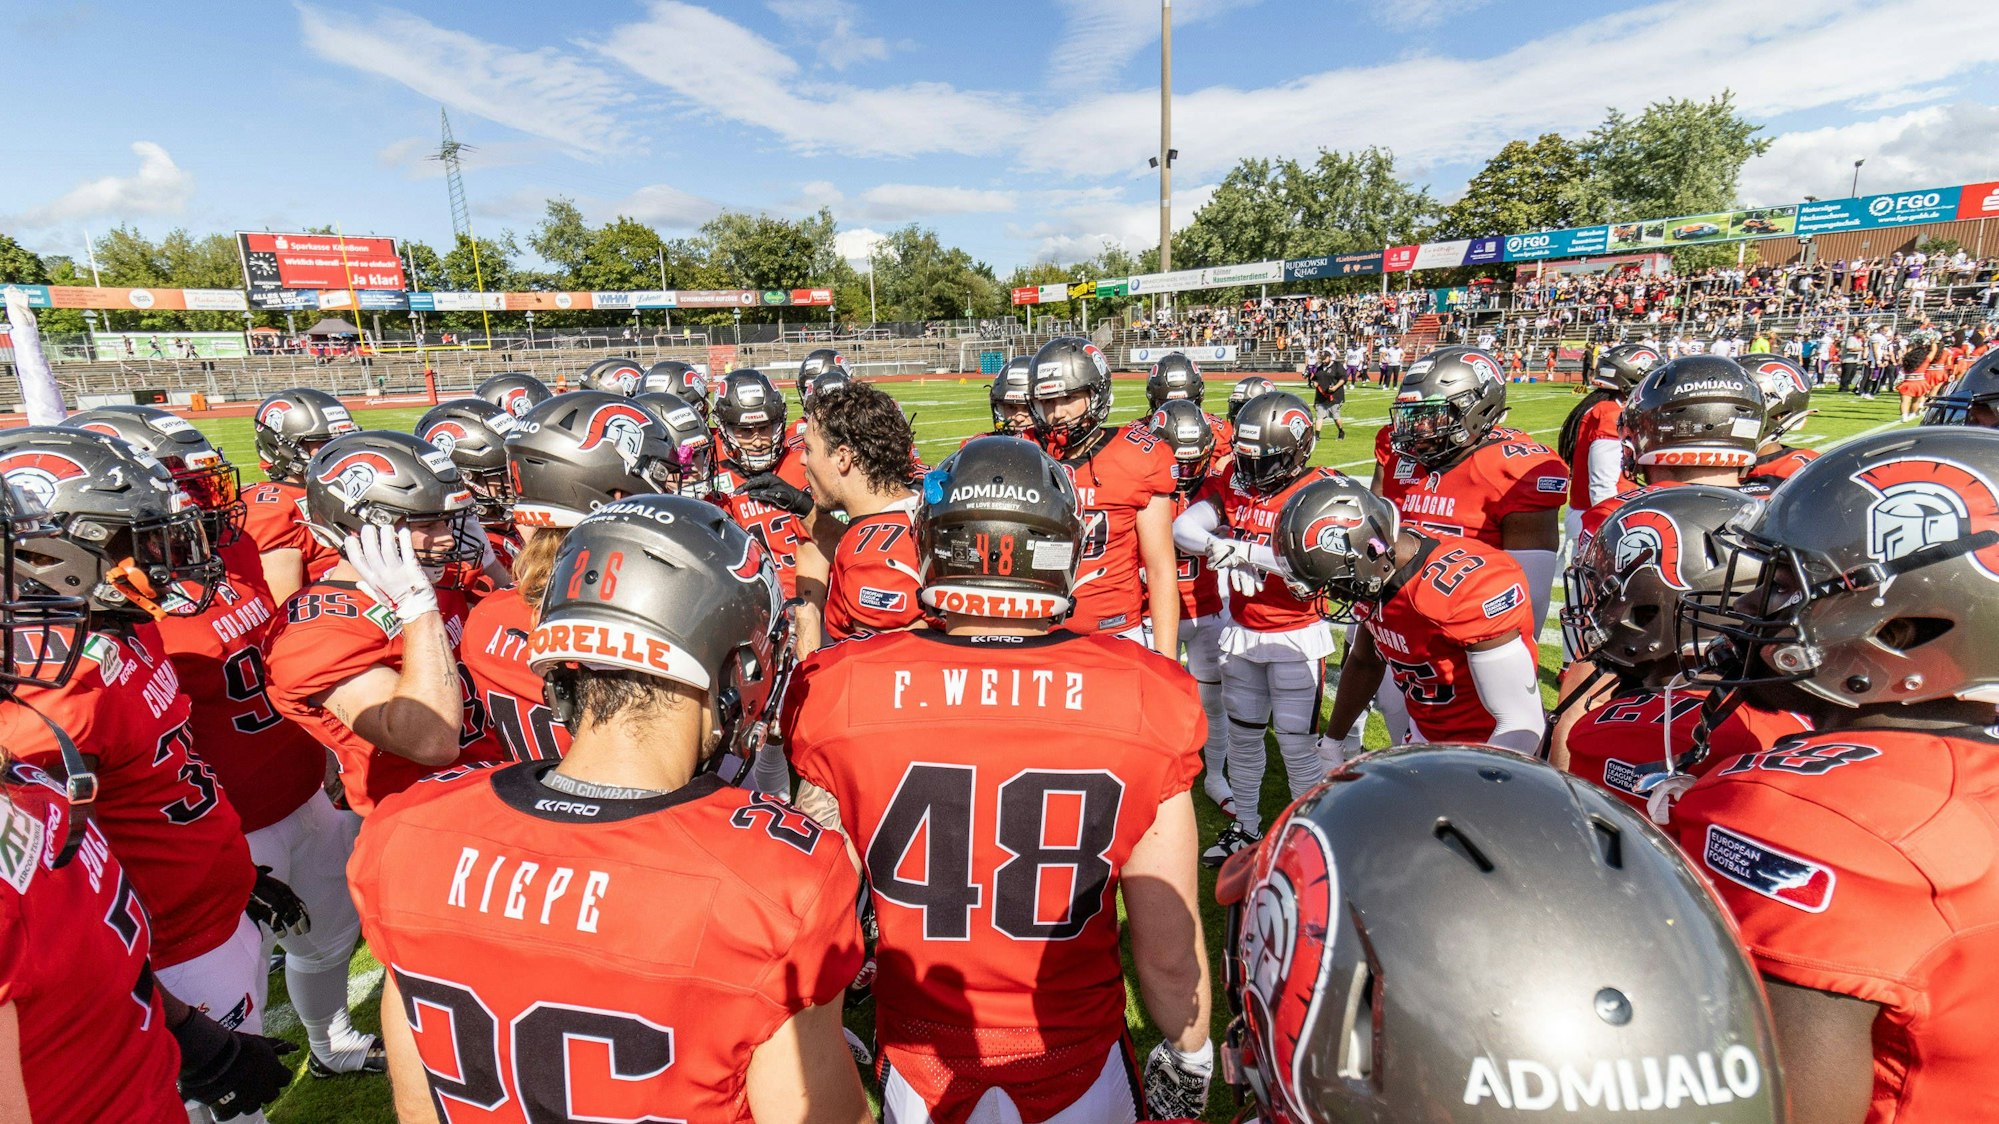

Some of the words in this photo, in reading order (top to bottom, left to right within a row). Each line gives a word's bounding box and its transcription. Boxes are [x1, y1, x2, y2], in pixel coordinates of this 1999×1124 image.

[1896, 193, 1940, 210] FGO
[291, 242, 330, 252] Sparkasse
[1522, 235, 1550, 247] FGO
[1212, 267, 1232, 276] Kölner
[1285, 258, 1328, 270] RUDKOWSKI
[352, 274, 366, 285] Ja
[369, 274, 399, 286] klar!
[1212, 272, 1269, 284] Hausmeisterdienst
[599, 294, 629, 304] WHM
[1673, 381, 1743, 395] ADMIJALO
[431, 457, 450, 467] DEFSHO
[1654, 452, 1749, 466] FORELLE
[949, 484, 1040, 504] ADMIJALO
[1402, 494, 1455, 517] COLOGNE
[854, 523, 907, 554] 77
[1421, 548, 1487, 597] 25
[287, 592, 357, 623] 85
[934, 590, 1055, 617] FORELLE
[212, 597, 271, 642] COLOGNE
[223, 645, 285, 734] 9
[552, 774, 574, 794] PRO
[576, 780, 647, 800] COMBAT
[1607, 774, 1633, 789] FOOTBA
[865, 761, 1125, 941] 48
[1710, 841, 1741, 863] LEAGUE
[1711, 832, 1760, 862] EUROPEAN
[19, 854, 34, 887] AIRCON
[1708, 850, 1750, 879] FOOTBALL
[448, 847, 610, 934] RIEPE
[391, 962, 687, 1124] 26
[1464, 1045, 1761, 1112] ADMIJALO
